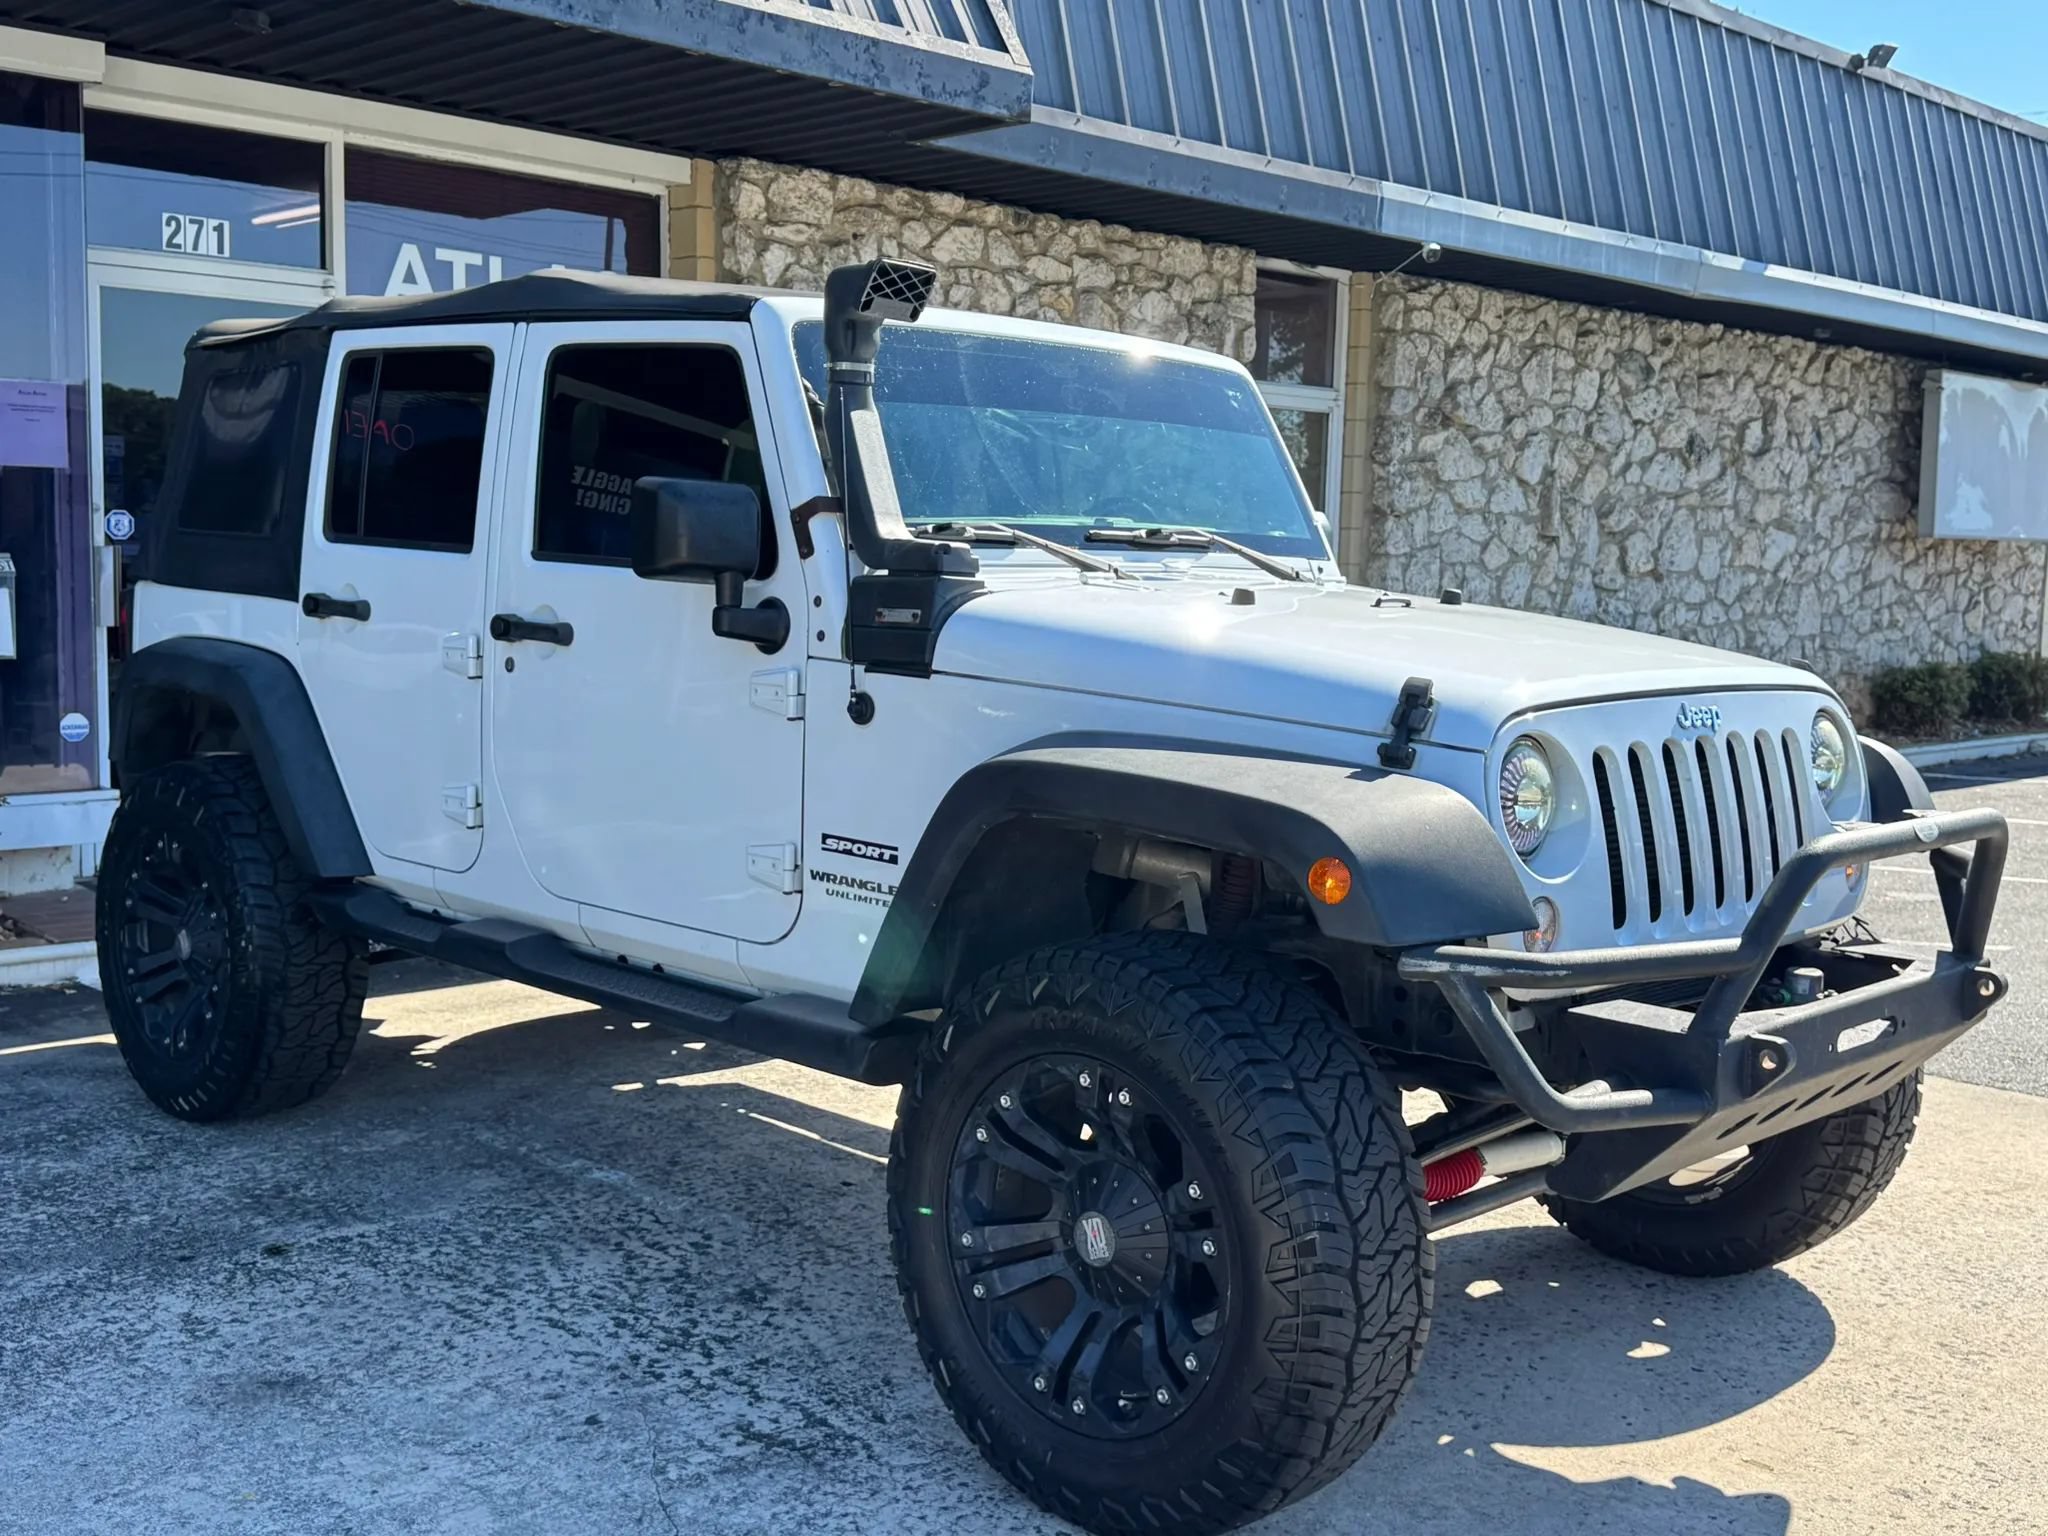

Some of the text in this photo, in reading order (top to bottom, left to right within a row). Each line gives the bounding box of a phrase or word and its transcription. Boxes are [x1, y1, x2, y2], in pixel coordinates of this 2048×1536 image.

[165, 215, 225, 255] 271
[1676, 701, 1721, 735] Jeep
[821, 837, 898, 861] SPORT
[810, 869, 899, 896] WRANGLE
[825, 888, 890, 908] UNLIMITE
[1082, 1218, 1106, 1251] XD
